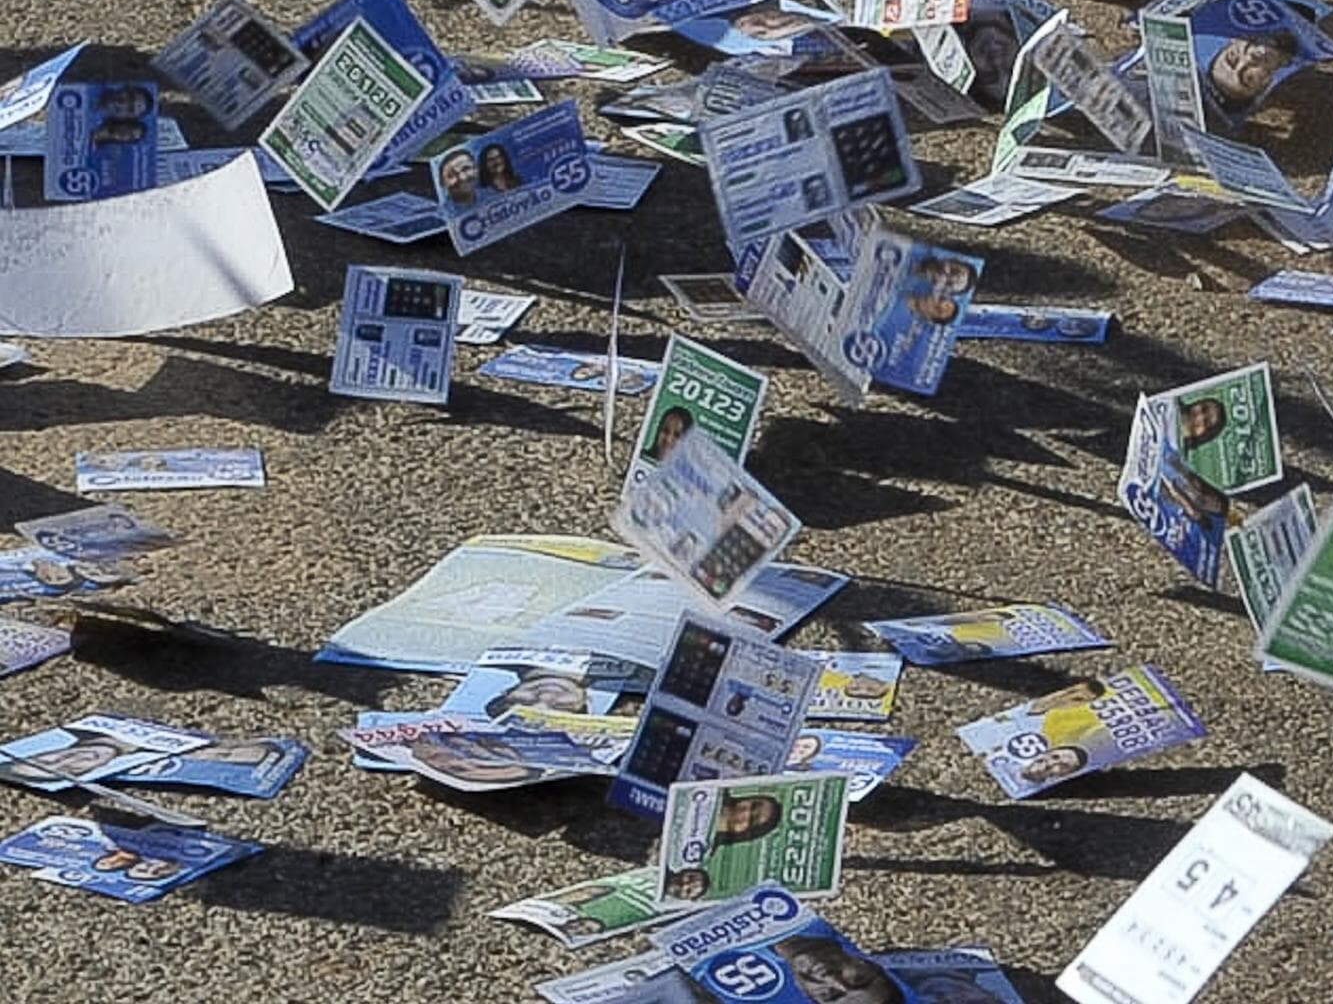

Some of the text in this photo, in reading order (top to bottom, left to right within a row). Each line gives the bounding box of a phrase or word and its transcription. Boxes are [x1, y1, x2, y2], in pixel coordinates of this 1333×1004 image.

[458, 157, 588, 241] Cristóvão 55
[668, 371, 744, 422] 20123
[1232, 388, 1254, 472] 20123
[1012, 733, 1046, 755] 55
[1090, 698, 1148, 749] 55888
[784, 786, 812, 884] 20123
[669, 893, 800, 958] Cristóvão
[712, 952, 778, 996] 55
